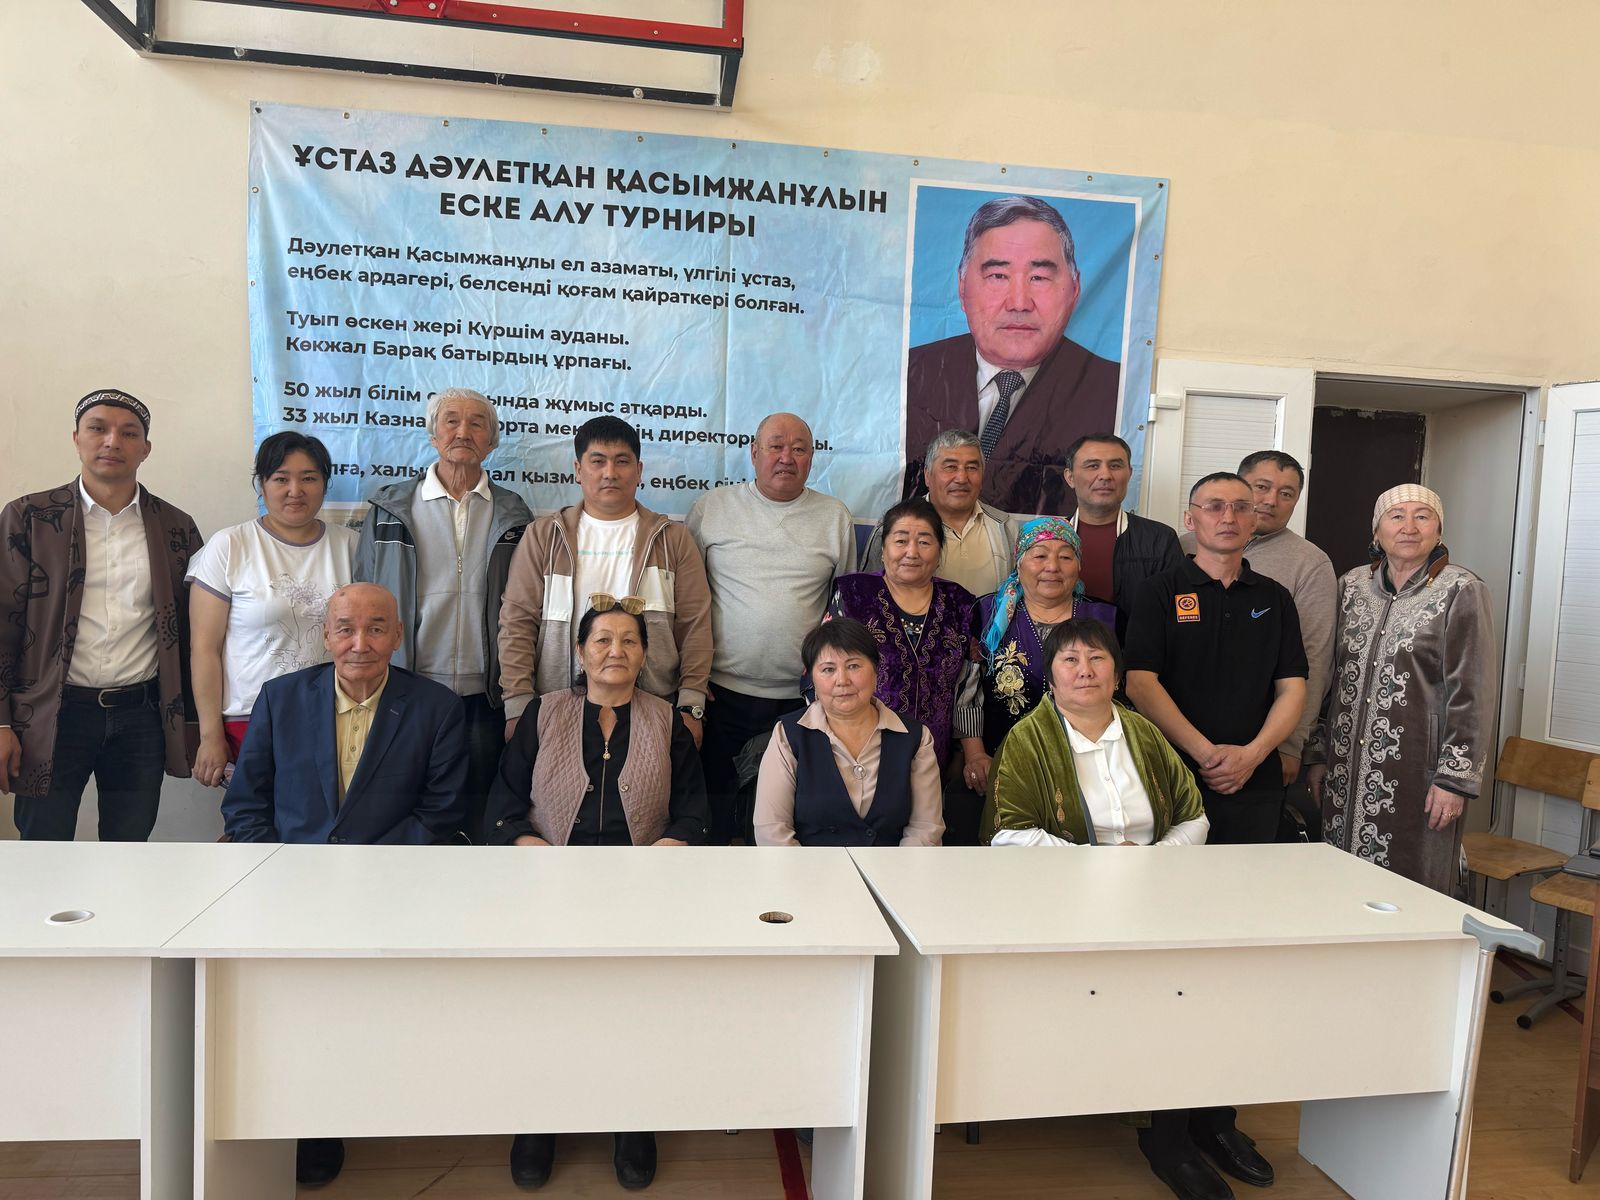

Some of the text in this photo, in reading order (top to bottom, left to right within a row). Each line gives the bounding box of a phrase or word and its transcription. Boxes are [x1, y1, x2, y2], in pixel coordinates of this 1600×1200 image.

[293, 145, 887, 213] ҰСТАЗ ДӘУЛЕТҚАН ҚАСЫМЖАНҰЛЫН
[441, 193, 754, 237] ЕСКЕ АЛУ ТУРНИРЫ
[288, 238, 795, 291] Дәулетқан Қасымжанұлы ел азаматы, үлгілі ұстаз,
[288, 265, 804, 313] еңбек ардагері, белсенді қоғам қайраткері болған.
[287, 311, 629, 345] Туып өскен жері Күршім ауданы.
[287, 337, 631, 370] Көкжал Барақ батырдың ұрпағы.
[283, 407, 306, 422] 33
[313, 413, 358, 424] жыл
[284, 382, 309, 397] 50
[315, 387, 360, 398] жыл
[368, 385, 420, 402] білім
[546, 399, 614, 414] жұмыс
[620, 403, 707, 419] атқарды.
[651, 475, 709, 490] еңбек
